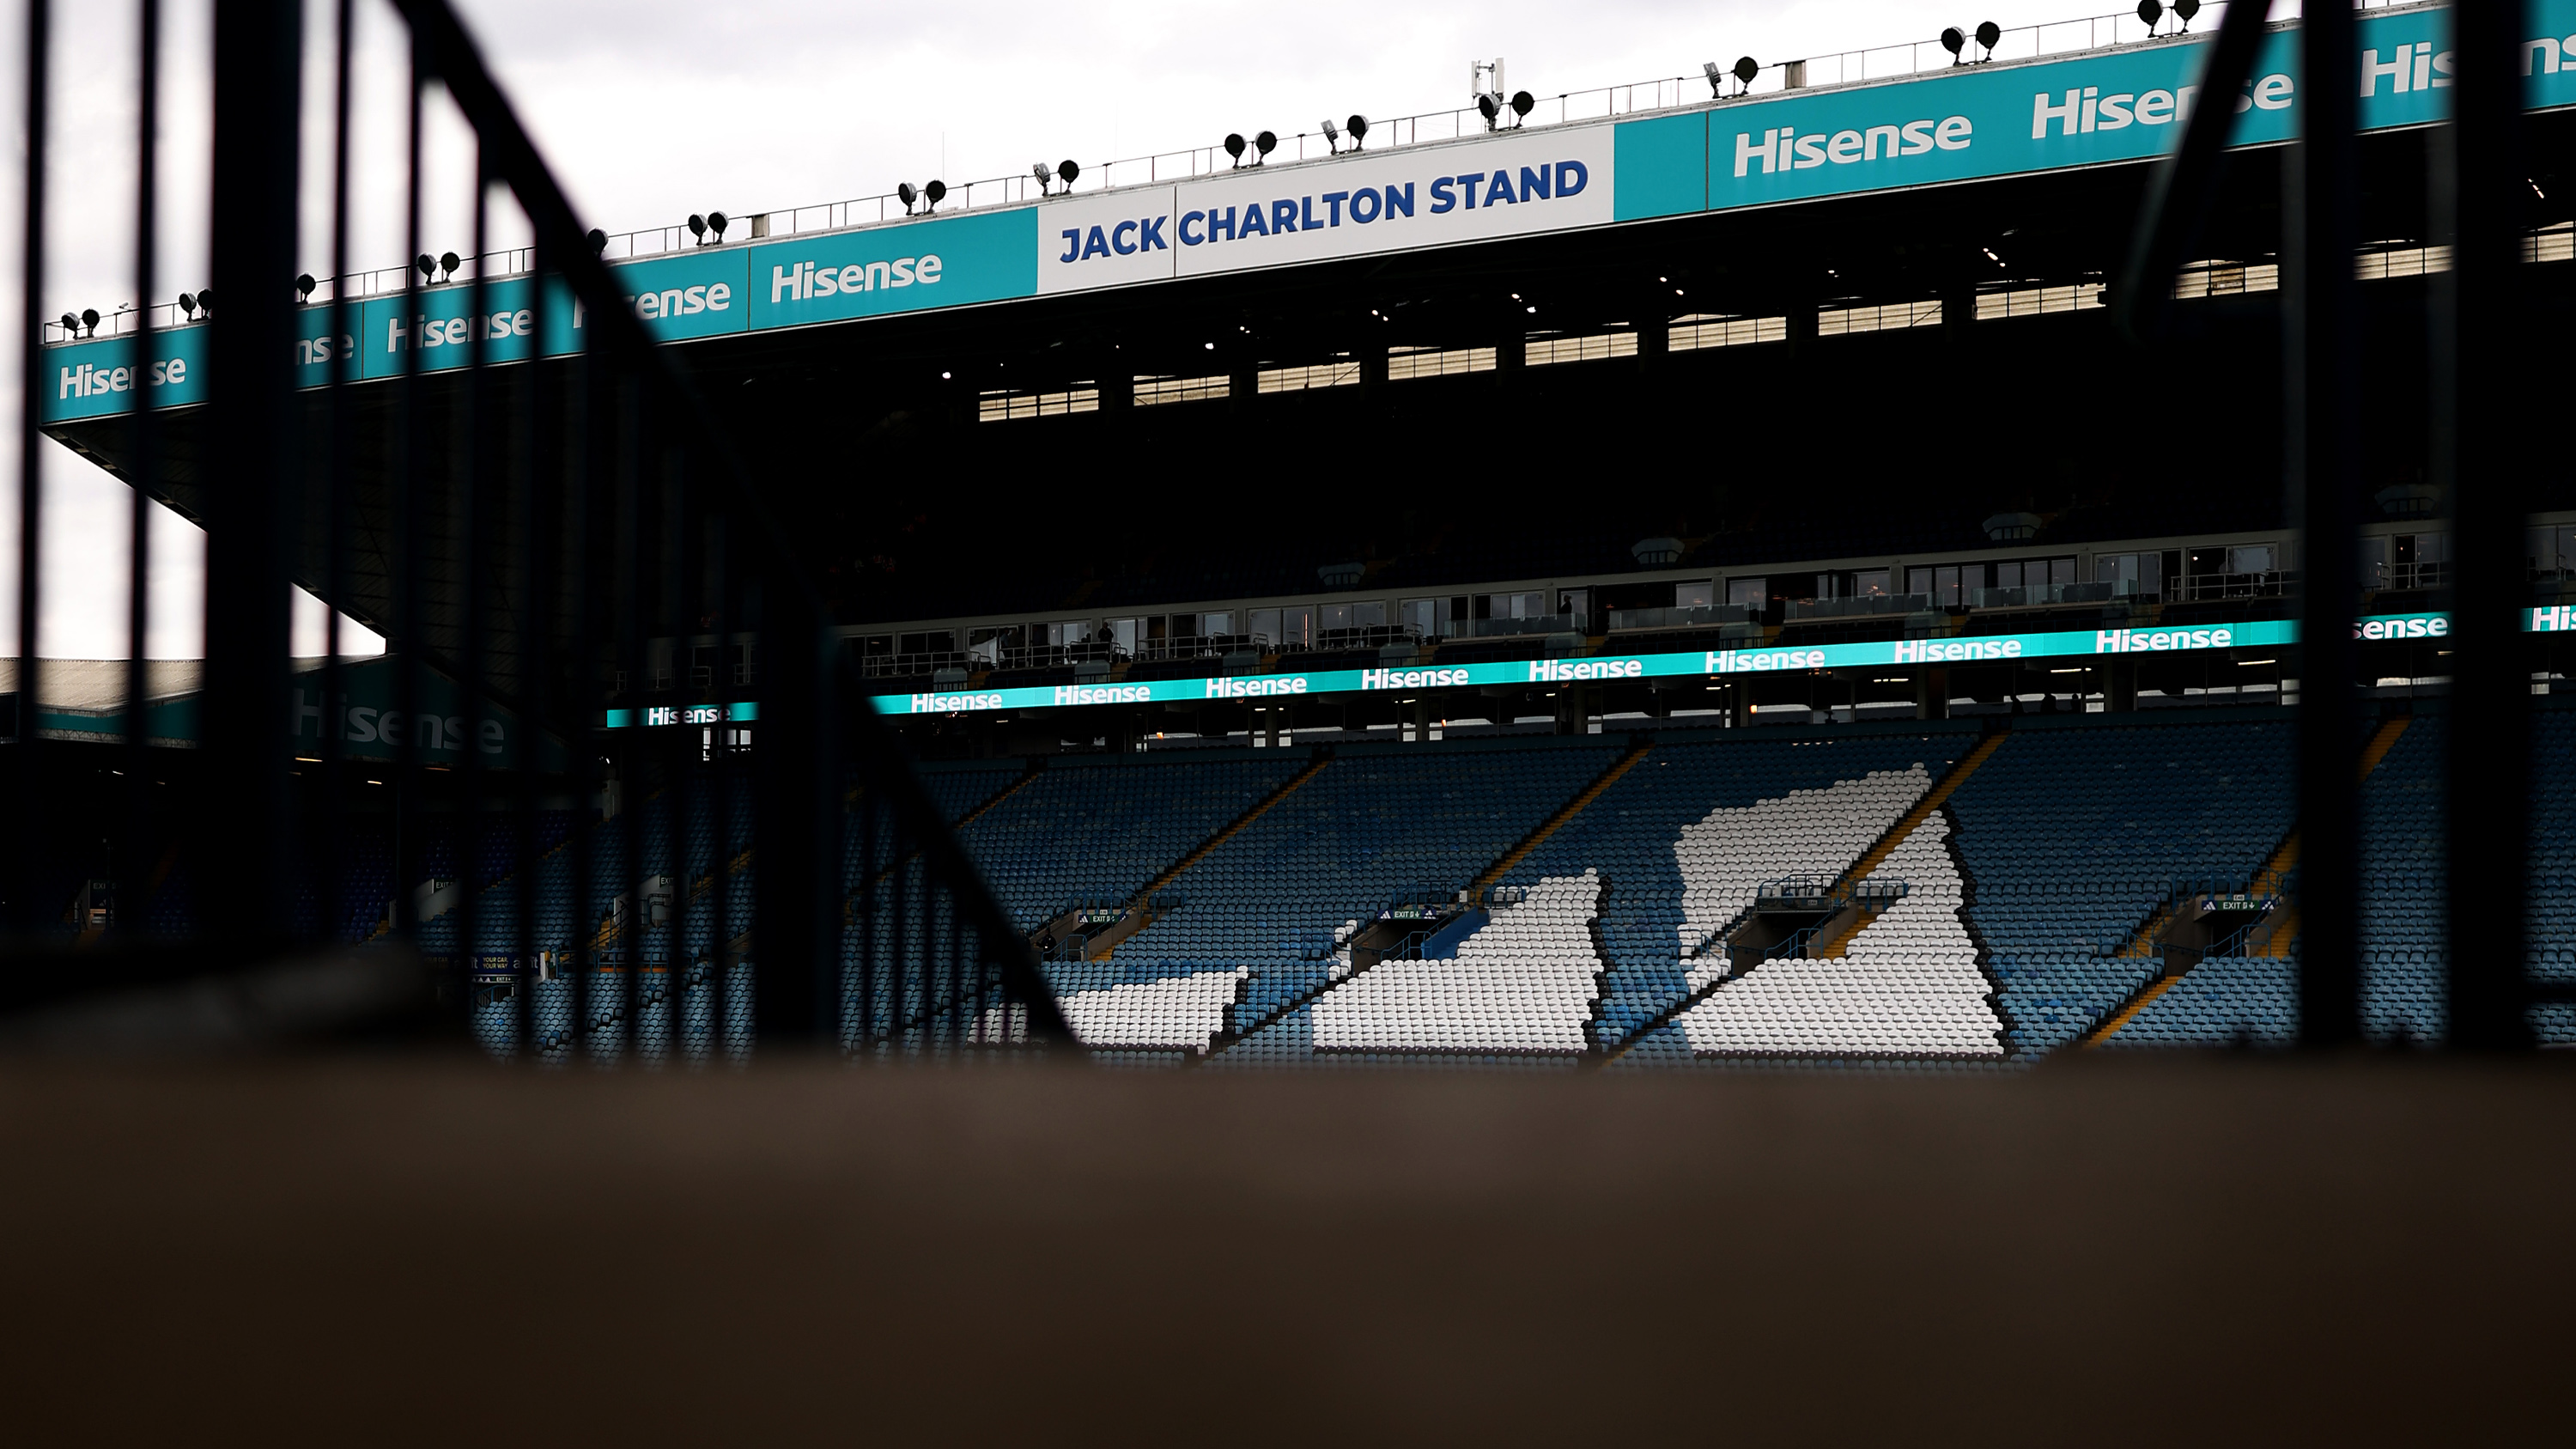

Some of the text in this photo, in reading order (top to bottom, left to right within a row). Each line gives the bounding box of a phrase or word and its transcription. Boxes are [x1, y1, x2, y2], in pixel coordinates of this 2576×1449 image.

[1734, 115, 1972, 177] Hisense
[1060, 160, 1589, 263] JACK CHARLTON STAND
[771, 254, 943, 303] Hisense
[1894, 640, 2022, 663] Hisense
[2095, 629, 2232, 653] Hisense
[1528, 659, 1642, 681] Hisense
[1705, 649, 1826, 673] Hisense
[1206, 678, 1308, 698] Hisense
[1361, 668, 1469, 690] Hisense
[911, 692, 1003, 713] Hisense
[1054, 685, 1151, 705] Hisense
[290, 687, 505, 754] Hisense
